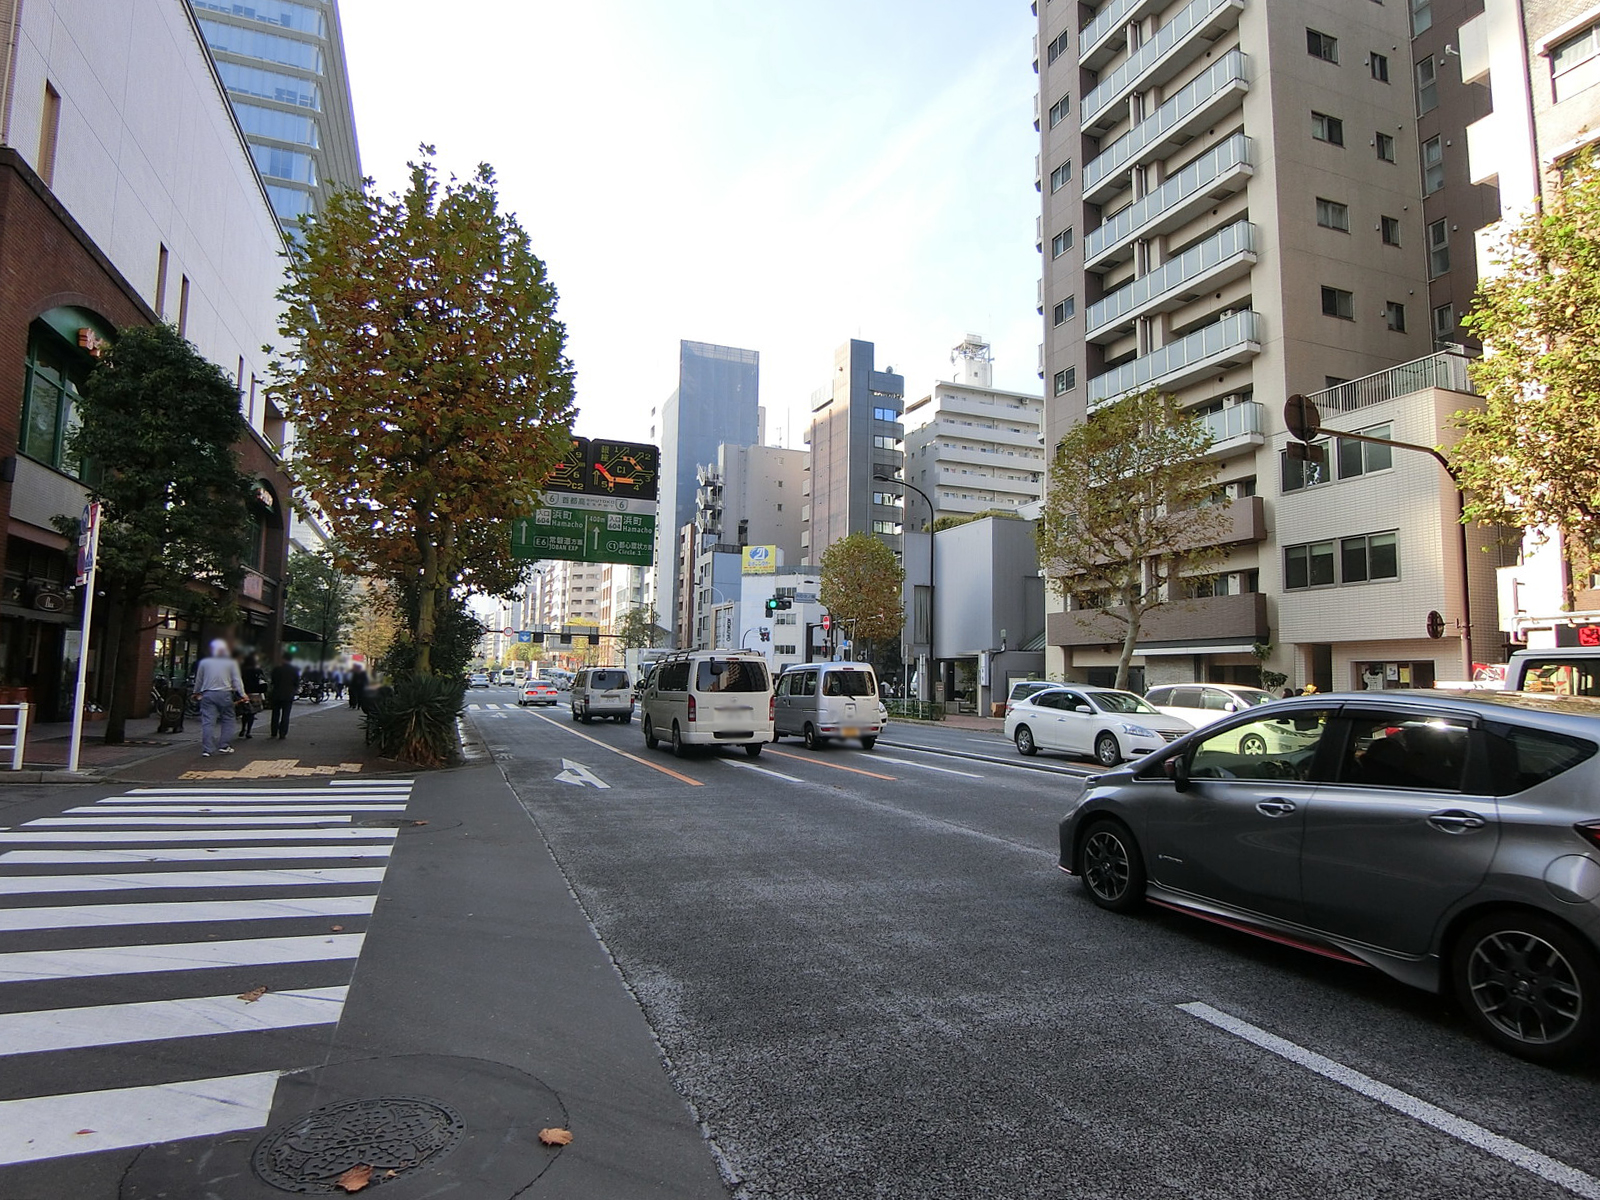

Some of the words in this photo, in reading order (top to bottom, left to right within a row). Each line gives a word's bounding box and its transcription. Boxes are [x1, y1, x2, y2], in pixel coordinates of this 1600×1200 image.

[616, 466, 626, 474] C1
[573, 471, 580, 479] 6
[645, 475, 651, 483] 3
[571, 482, 584, 490] C2
[601, 480, 608, 488] 5
[562, 496, 585, 505] 首都高
[552, 509, 572, 520] 浜町
[589, 515, 606, 523] 400m
[623, 515, 642, 526] 浜町
[551, 519, 583, 528] Hamacho
[608, 522, 621, 530] 604
[623, 525, 653, 534] Hamacho
[535, 538, 547, 546] E6
